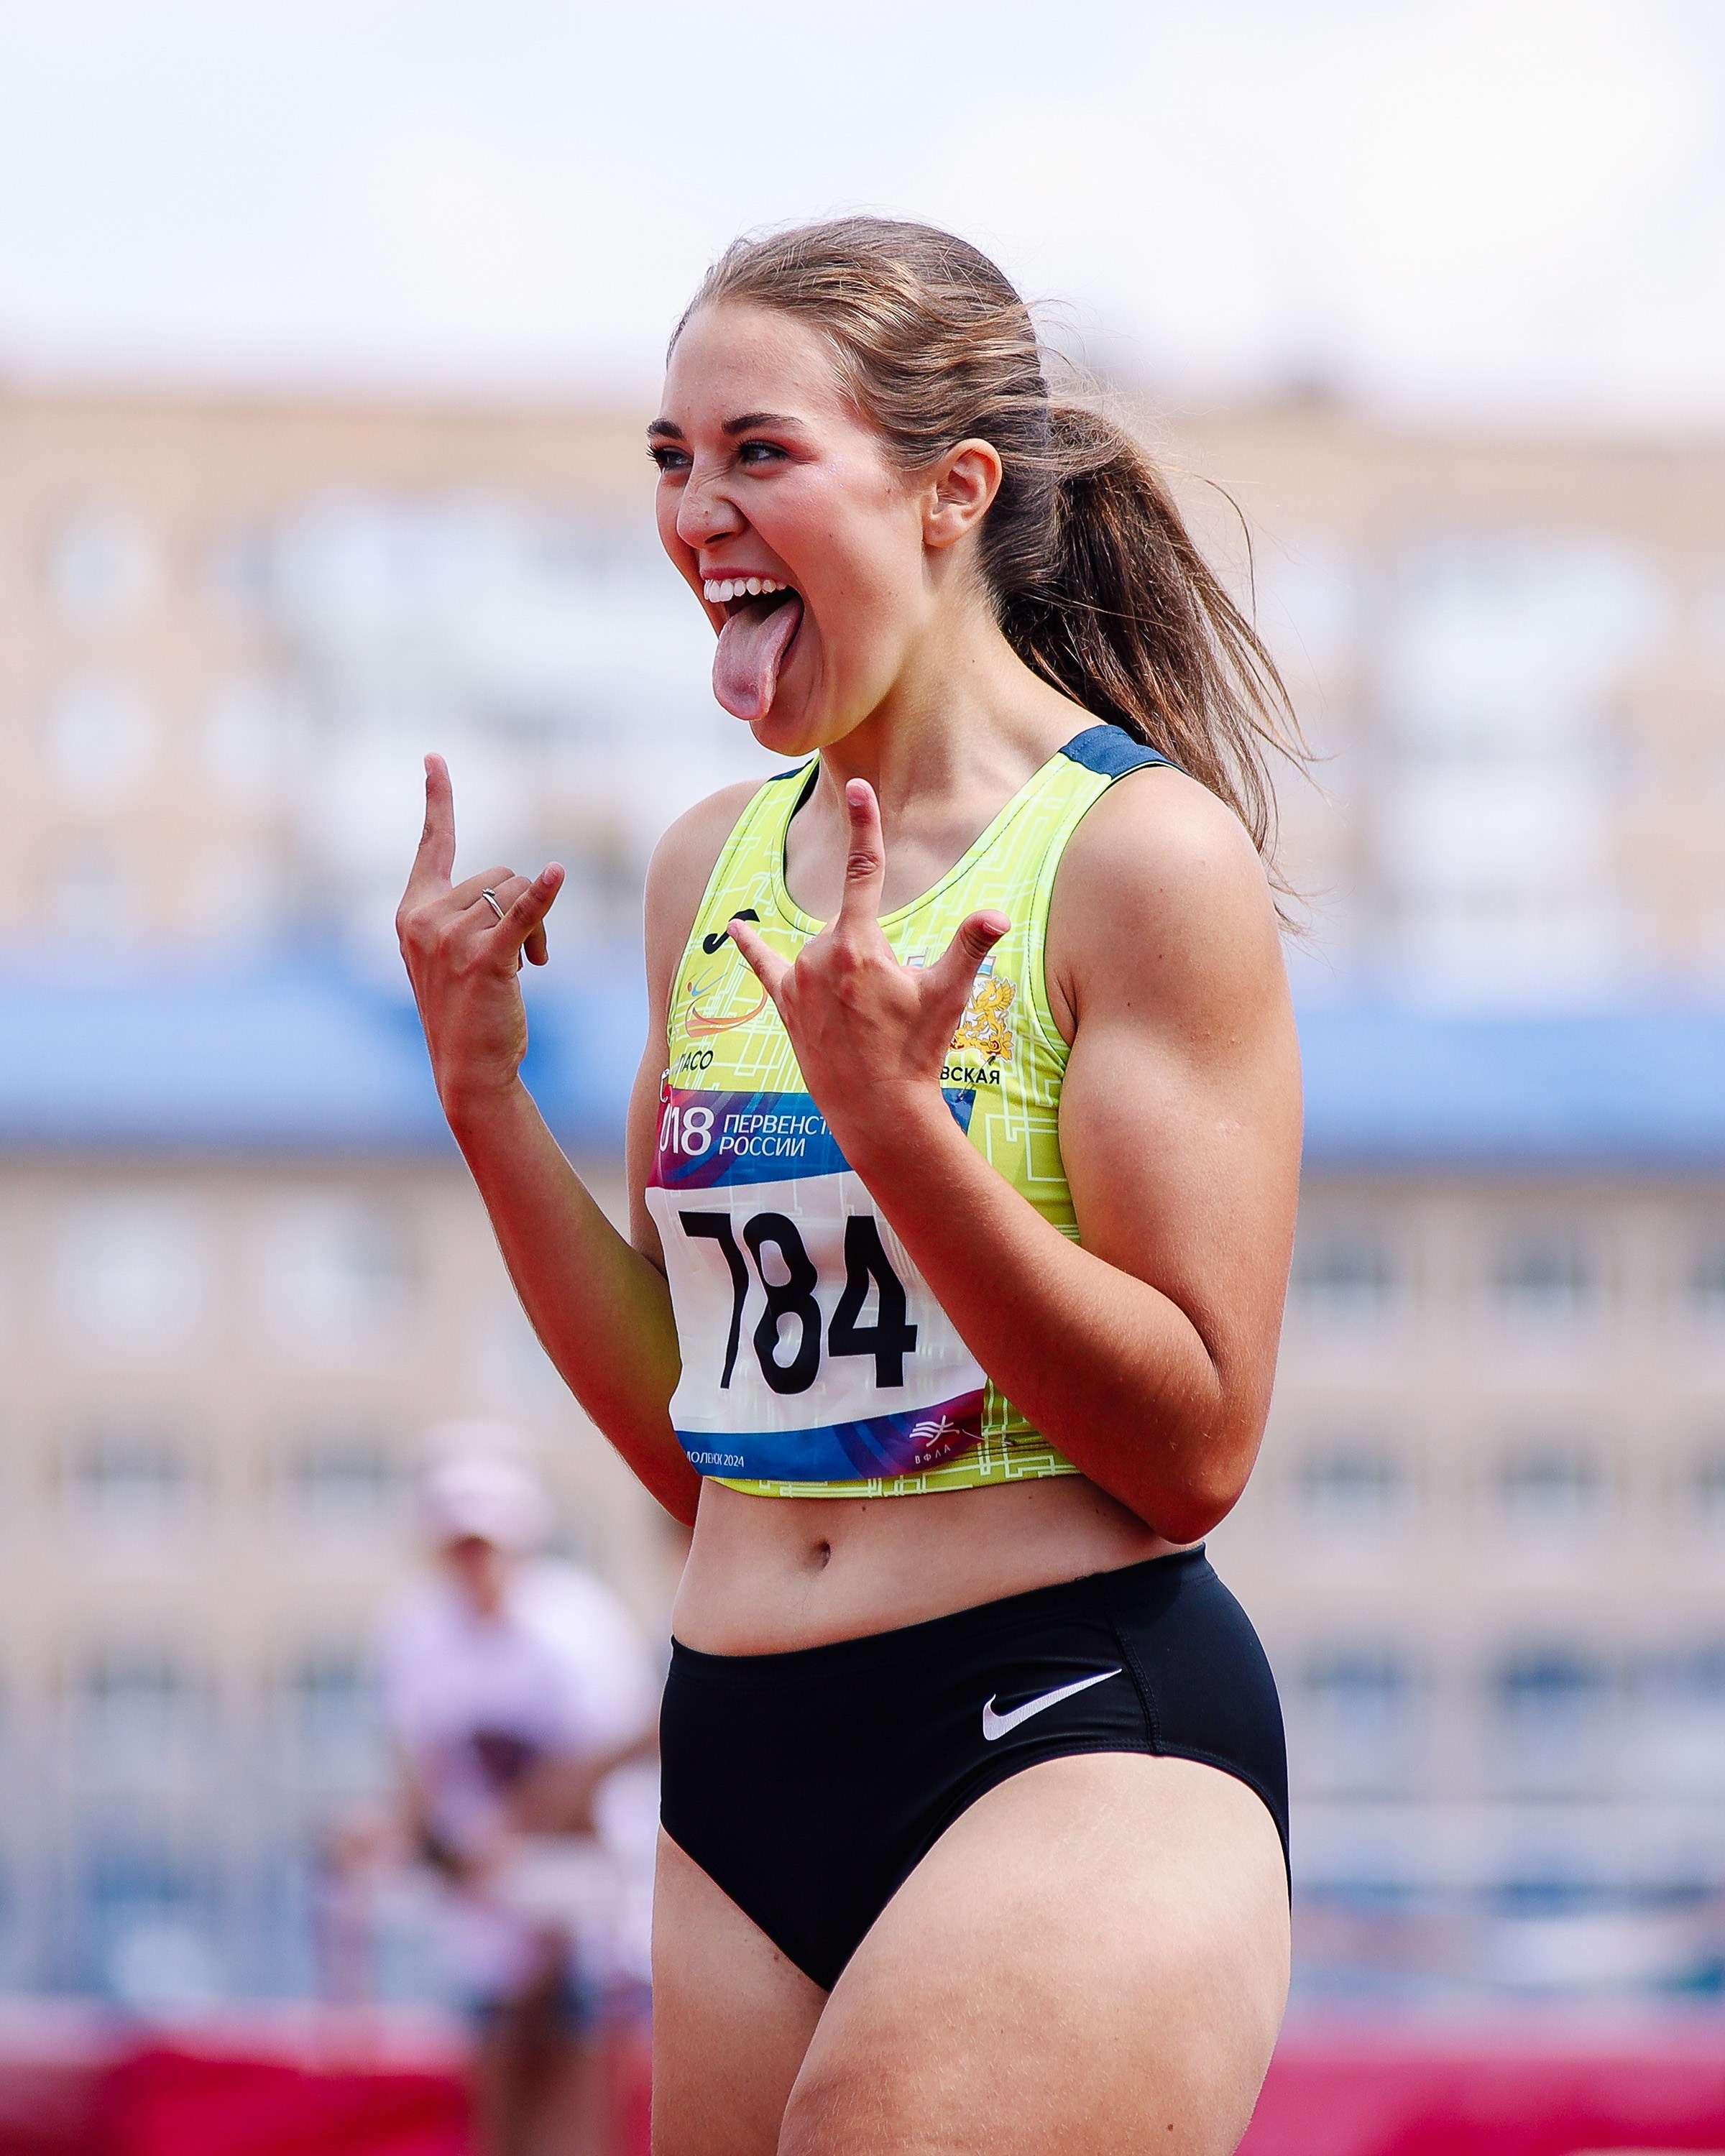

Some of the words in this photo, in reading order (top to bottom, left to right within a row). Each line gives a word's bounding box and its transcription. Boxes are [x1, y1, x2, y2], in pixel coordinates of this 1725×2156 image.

[940, 1066, 1000, 1085] ВСКАЯ
[723, 1114, 832, 1136] ПЕРВЕНСТ
[719, 1135, 806, 1157] РОССИИ
[678, 1210, 919, 1395] 784
[723, 1454, 745, 1468] 2024
